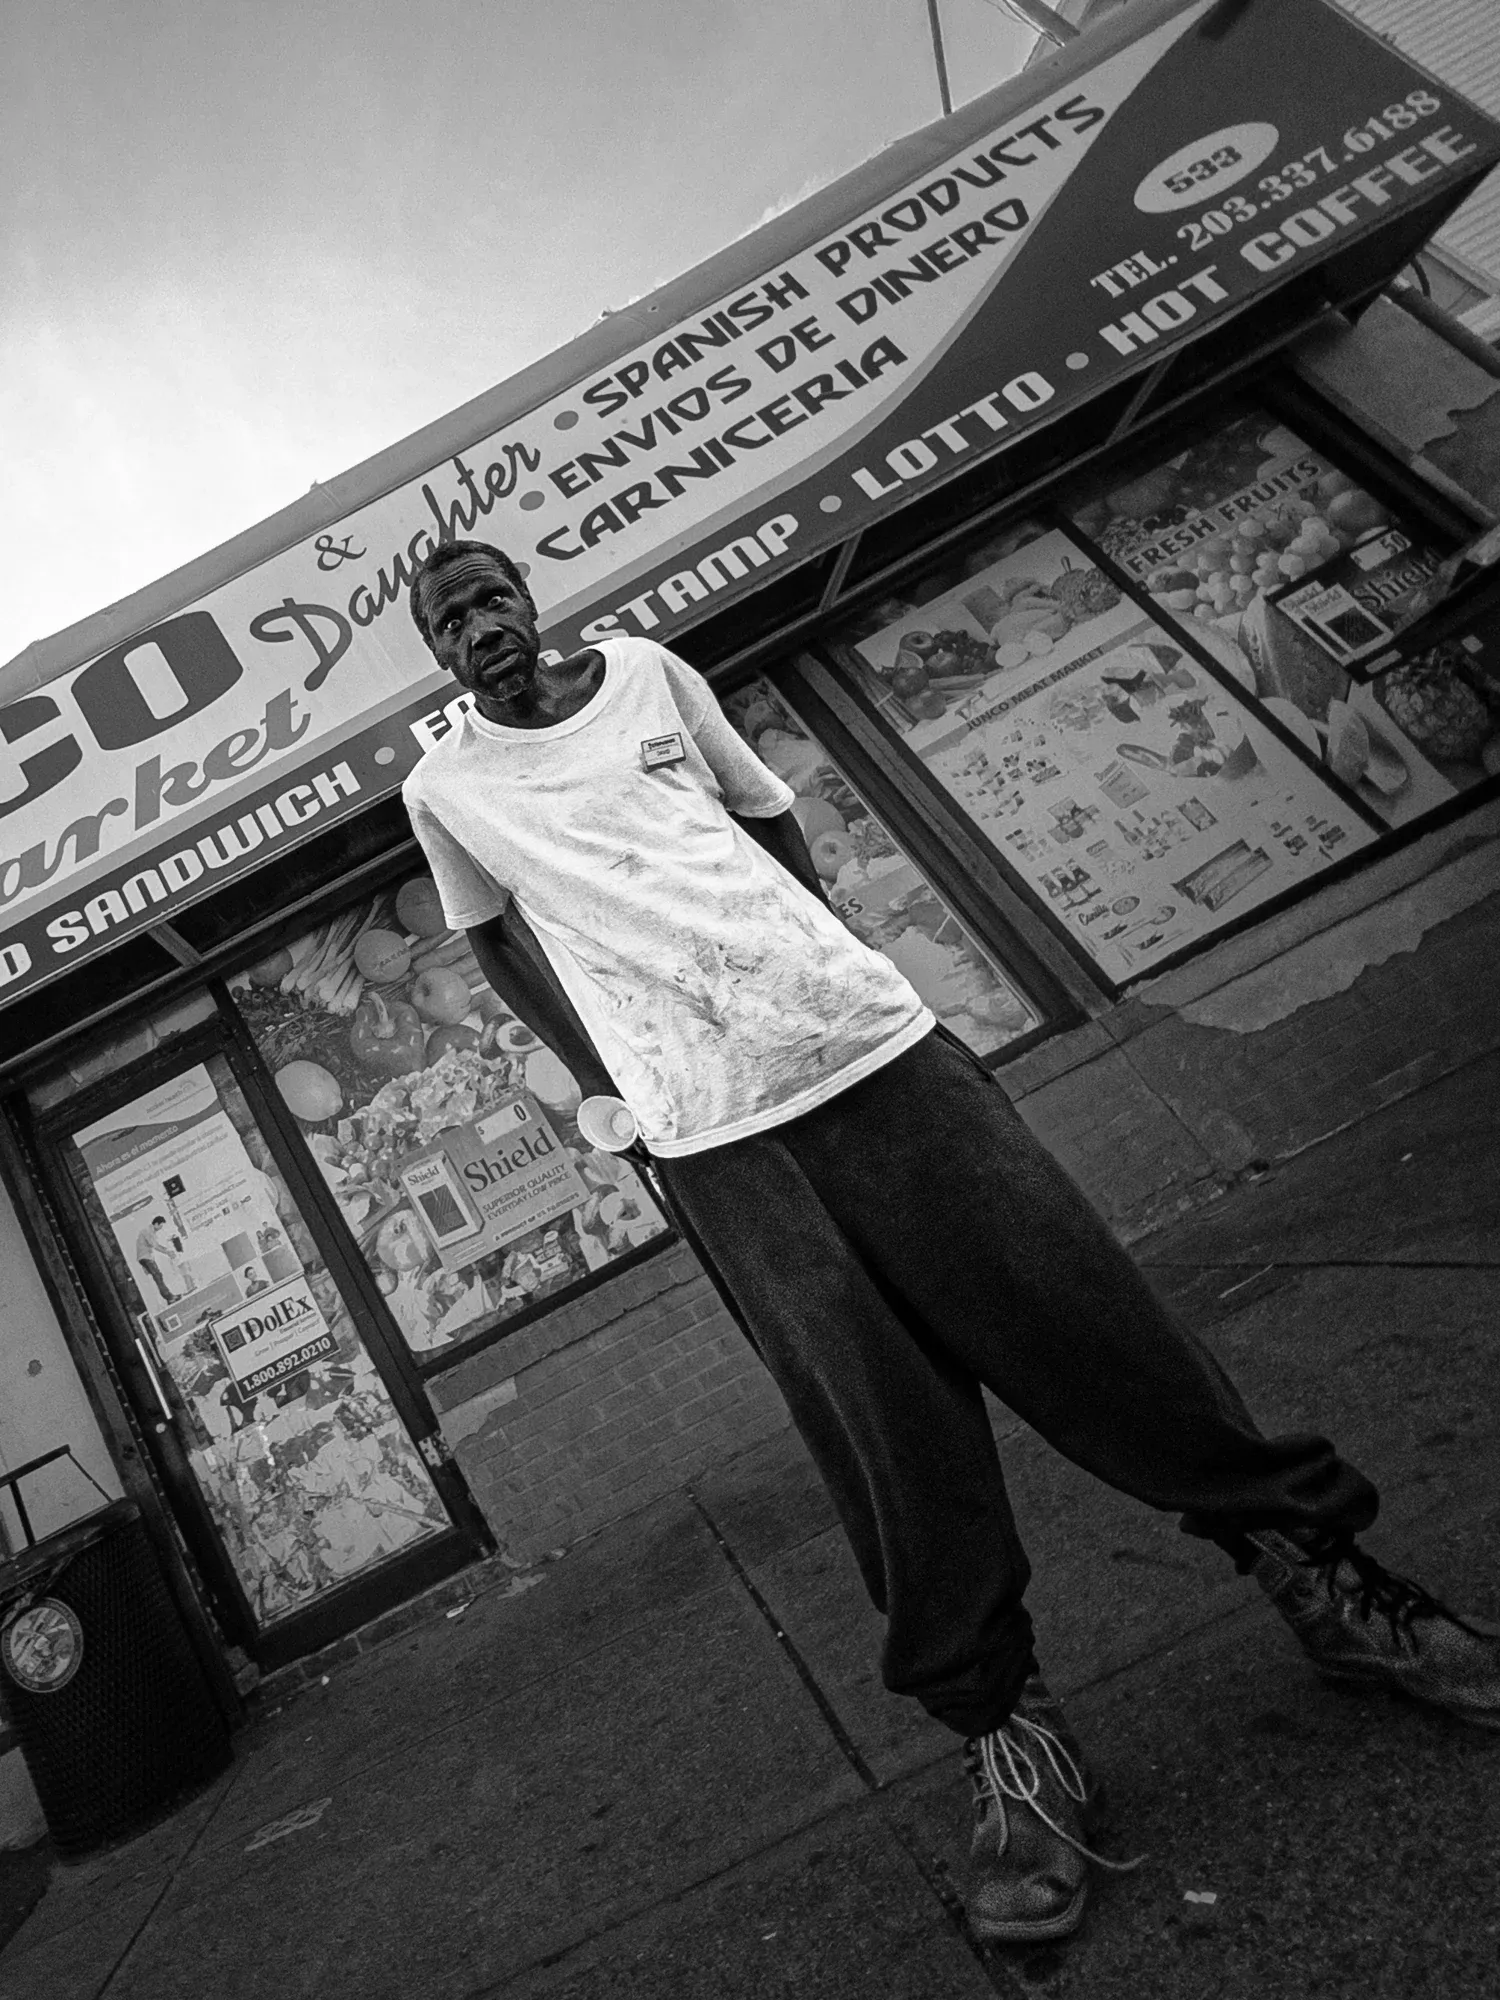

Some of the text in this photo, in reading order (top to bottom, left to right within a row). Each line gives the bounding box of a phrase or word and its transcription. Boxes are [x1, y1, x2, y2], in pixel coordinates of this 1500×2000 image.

[1090, 90, 1440, 298] TEL. 203.337.6188
[1162, 145, 1243, 195] 533
[582, 95, 1105, 418] SPANISH PRODUCTS
[548, 196, 1030, 498] ENVIOS DE DINERO
[535, 335, 908, 561] CARNICERIA
[46, 760, 361, 953] SANDWICH
[580, 513, 798, 641] STAMP
[852, 371, 1055, 500] LOTTO
[1099, 265, 1229, 356] HOT
[1239, 125, 1477, 272] COFFEE
[1126, 460, 1319, 574] FRESH FRUITS
[315, 534, 367, 571] &
[966, 647, 1104, 731] JUNCO MEAT MARKET
[95, 1125, 178, 1174] Ahora es el momento
[407, 1165, 440, 1186] Shield
[464, 1127, 556, 1192] Shield
[482, 1163, 565, 1213] SUPERIOR QUALITY
[487, 1172, 571, 1220] EVERYDAY LOW PRICE
[241, 1296, 314, 1342] DolEx
[242, 1337, 331, 1391] 1.800.892.0210
